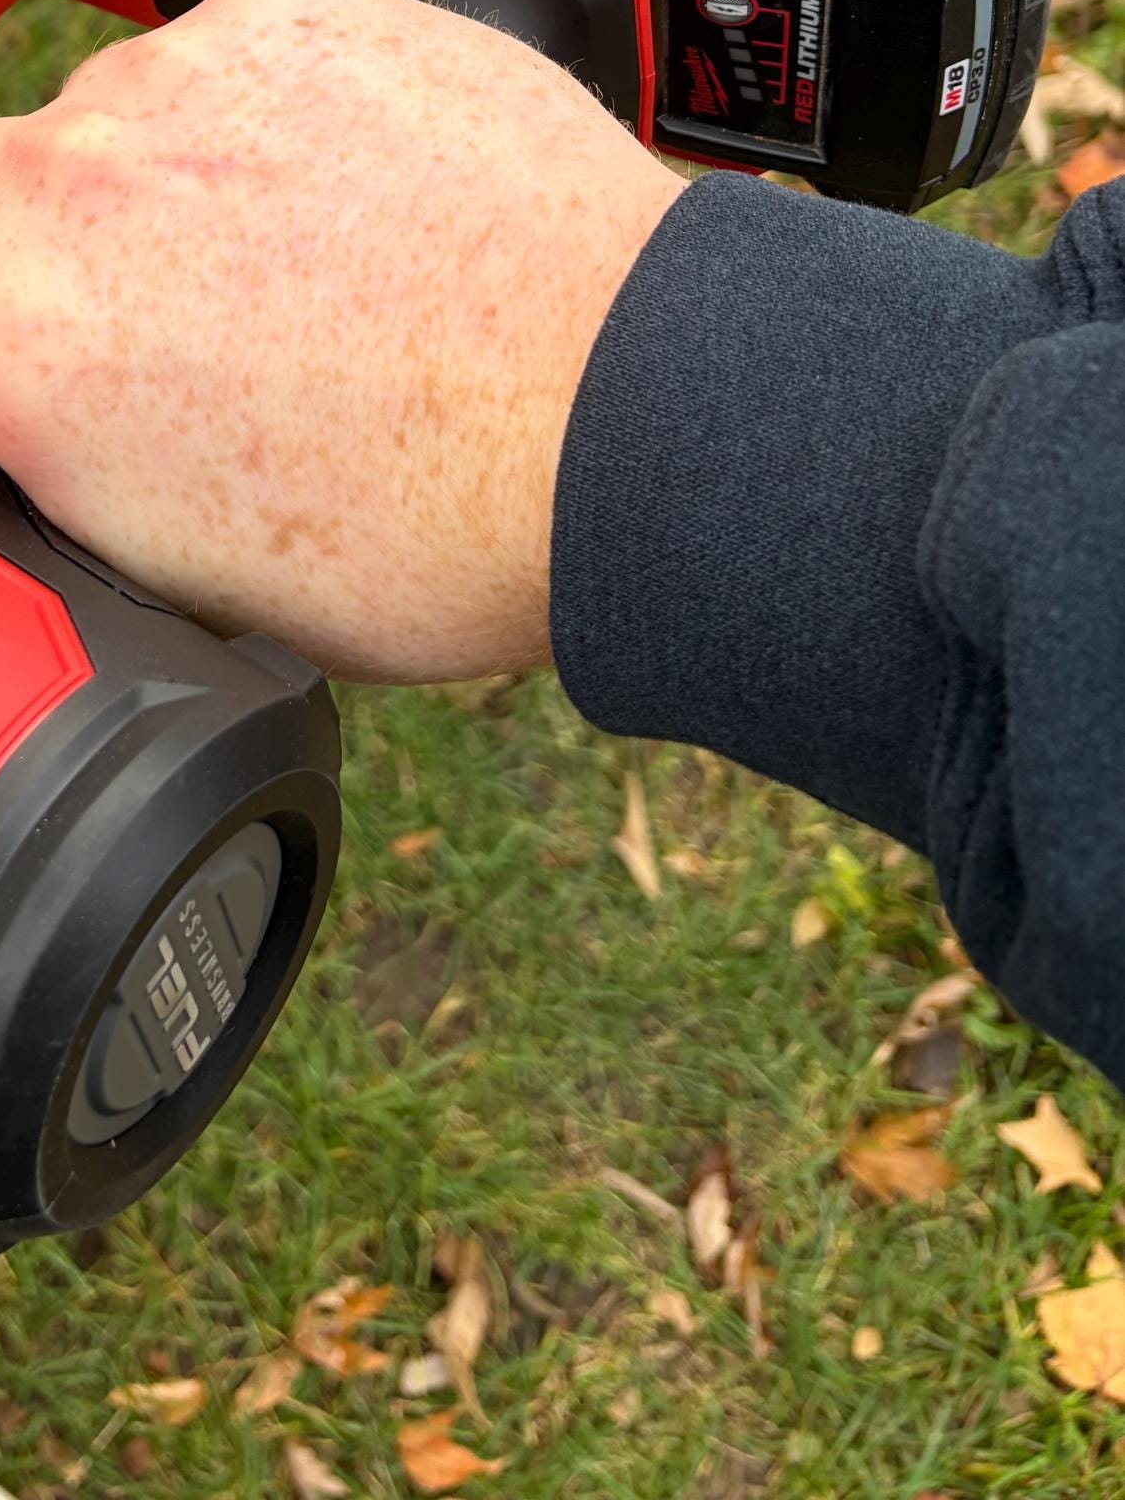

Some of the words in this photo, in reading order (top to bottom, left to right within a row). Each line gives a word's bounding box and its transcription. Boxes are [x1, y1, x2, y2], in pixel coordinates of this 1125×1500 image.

[683, 46, 719, 116] Milwaukee
[943, 64, 966, 111] M18
[967, 47, 985, 104] CP3.0
[179, 900, 236, 1023] BRUSHLESS
[146, 934, 211, 1072] FUEL
